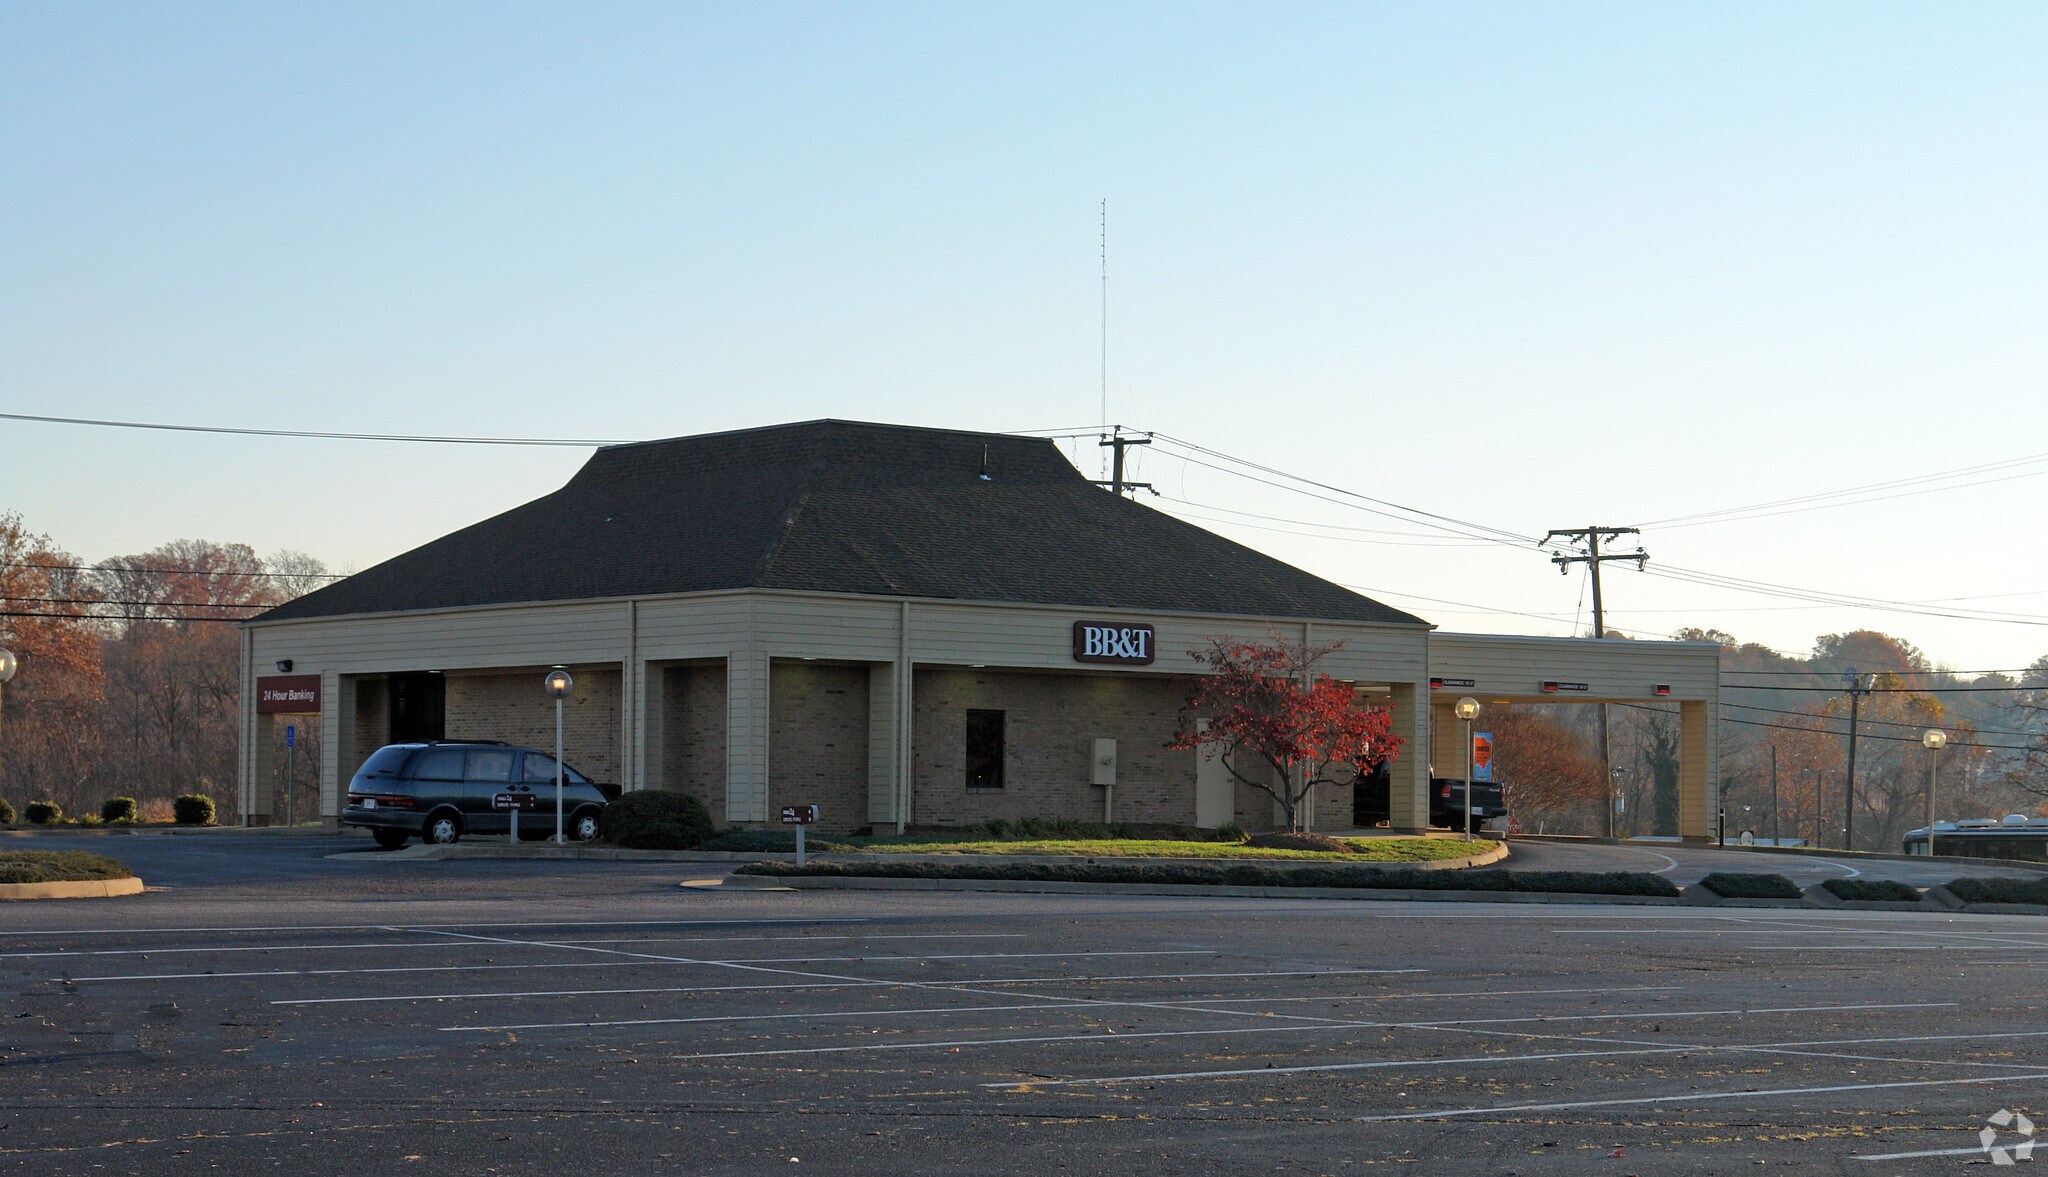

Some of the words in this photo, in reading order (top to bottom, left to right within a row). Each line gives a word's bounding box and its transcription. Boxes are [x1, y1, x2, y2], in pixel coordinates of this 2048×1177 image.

[1082, 626, 1152, 658] BB&T
[263, 690, 271, 701] 24
[272, 690, 288, 701] Hour
[288, 689, 315, 702] Banking
